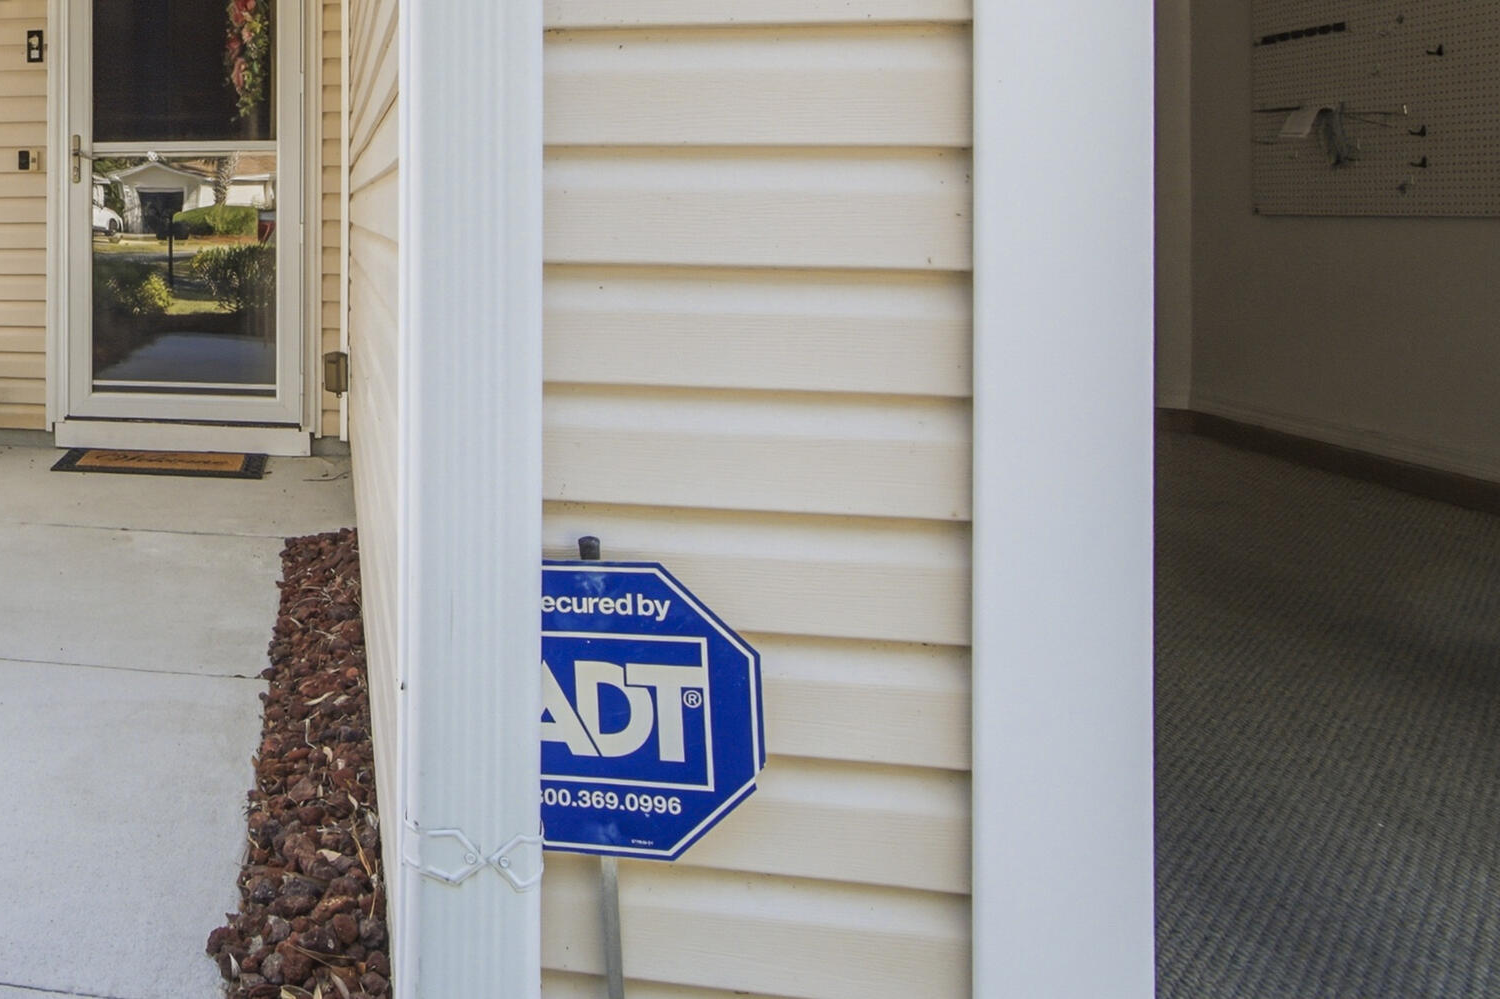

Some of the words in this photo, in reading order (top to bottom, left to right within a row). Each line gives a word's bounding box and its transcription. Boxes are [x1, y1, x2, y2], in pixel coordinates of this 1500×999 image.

[541, 593, 633, 615] ecured
[636, 593, 671, 621] by
[541, 788, 682, 815] 00.369.0996
